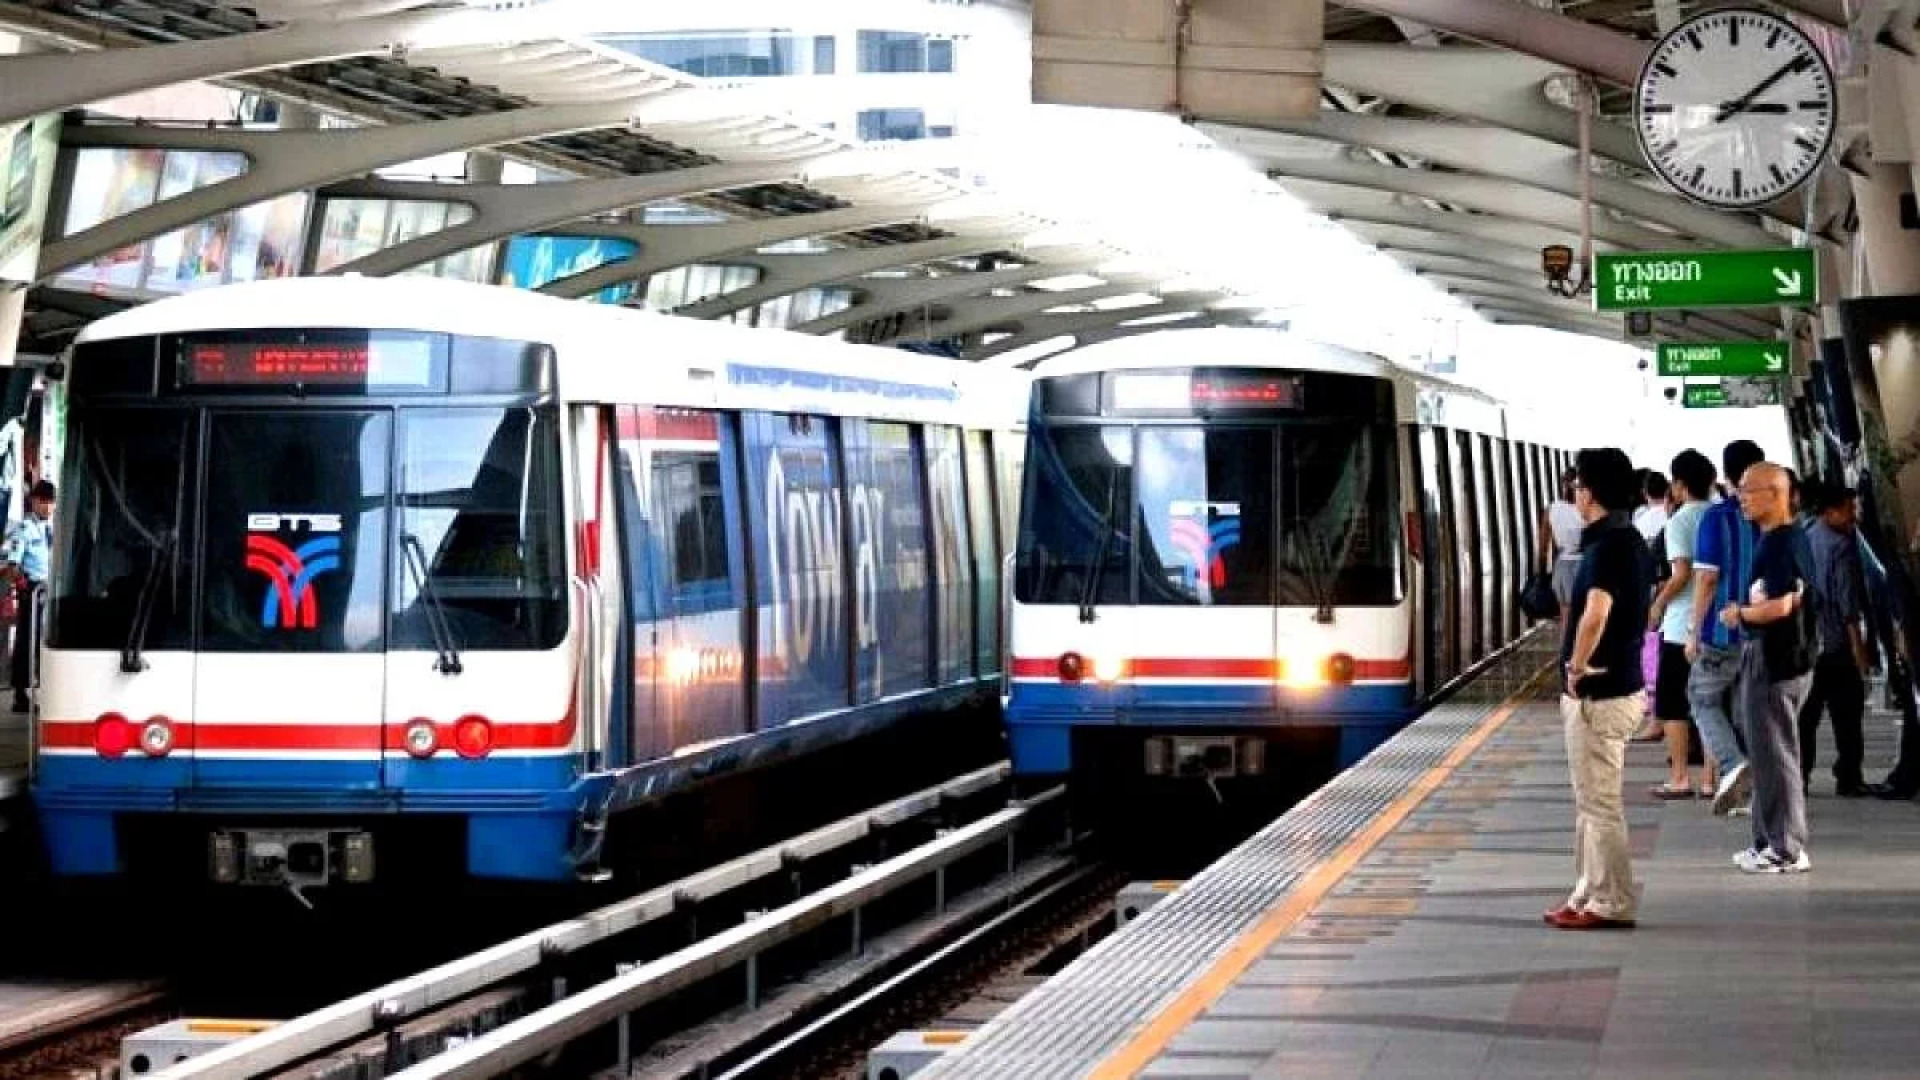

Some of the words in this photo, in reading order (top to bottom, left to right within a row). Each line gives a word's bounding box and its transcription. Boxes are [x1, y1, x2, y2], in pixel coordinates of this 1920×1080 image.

[1612, 260, 1702, 281] ทางออก
[1615, 284, 1652, 301] Exit
[247, 513, 342, 532] BTS
